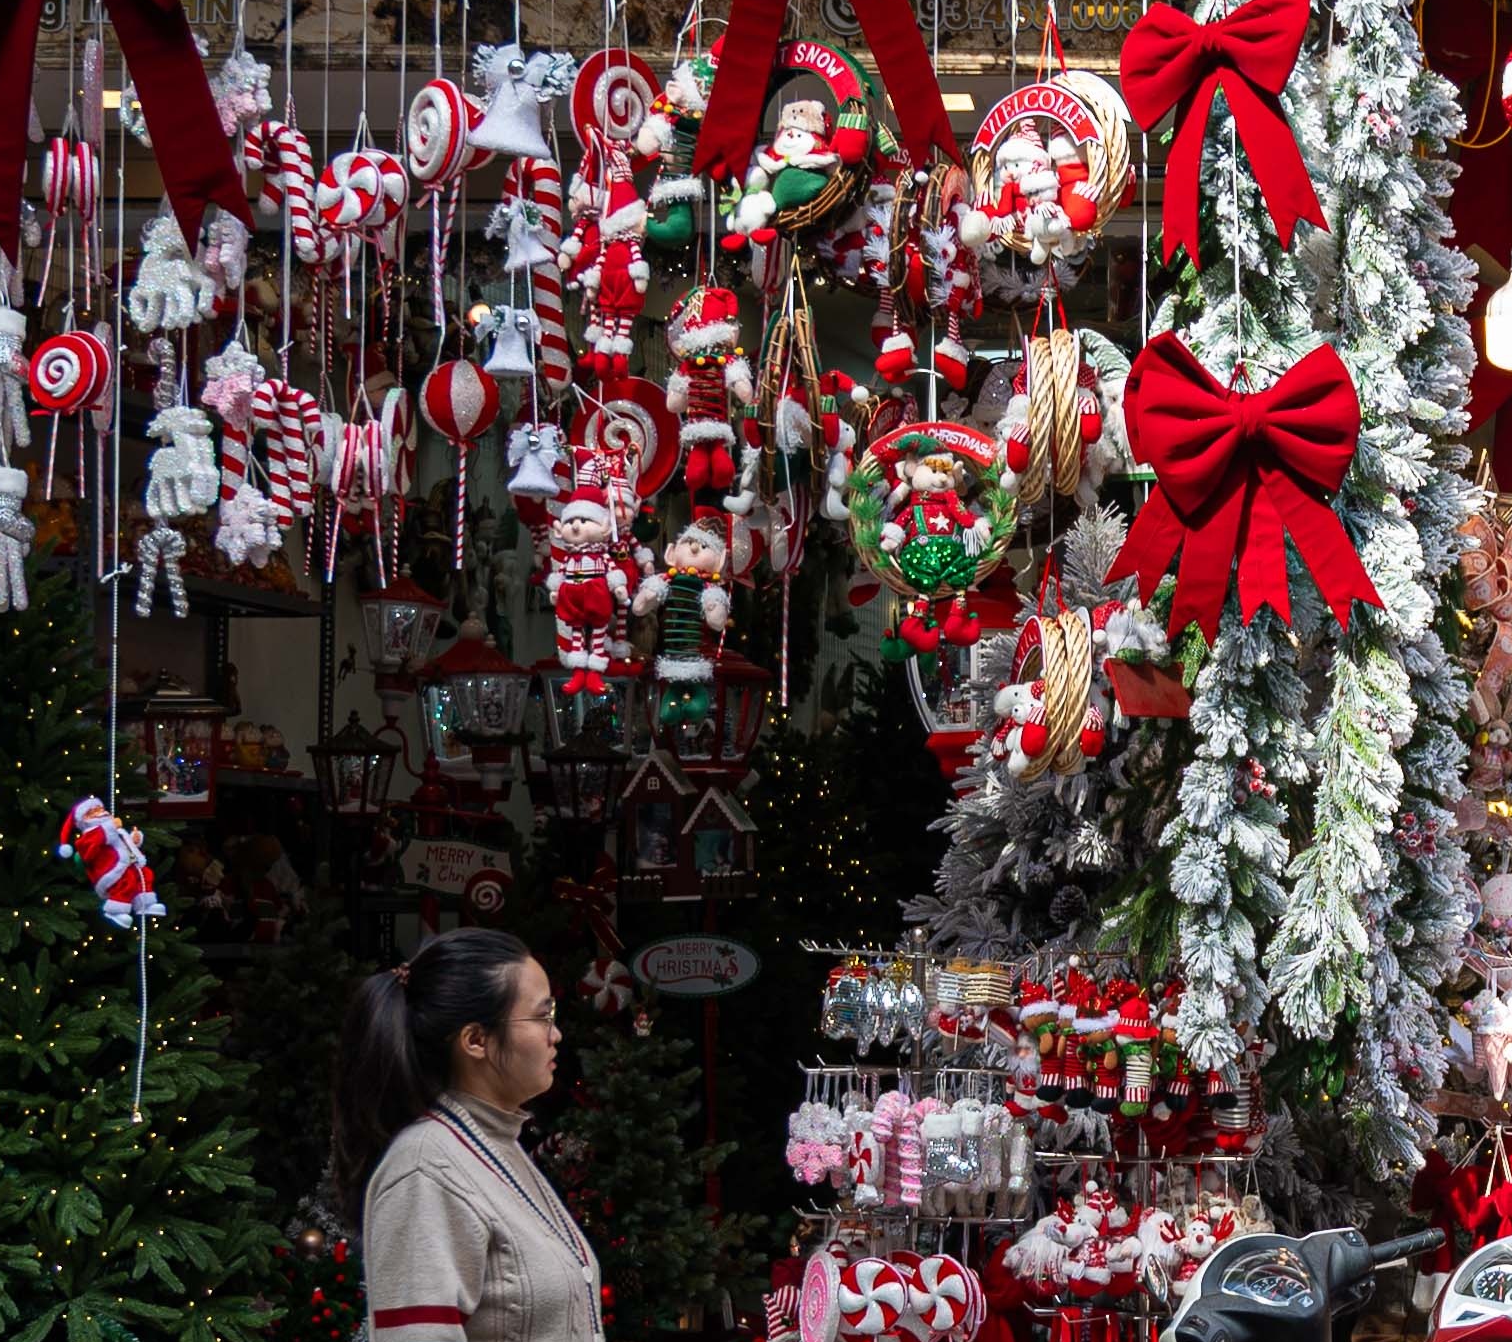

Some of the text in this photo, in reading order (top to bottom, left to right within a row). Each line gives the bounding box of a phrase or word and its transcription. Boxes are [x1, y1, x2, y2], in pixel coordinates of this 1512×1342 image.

[794, 42, 844, 78] SNOW
[984, 88, 1083, 135] WELCOME
[427, 846, 475, 865] MERRY
[676, 942, 713, 955] MERRY
